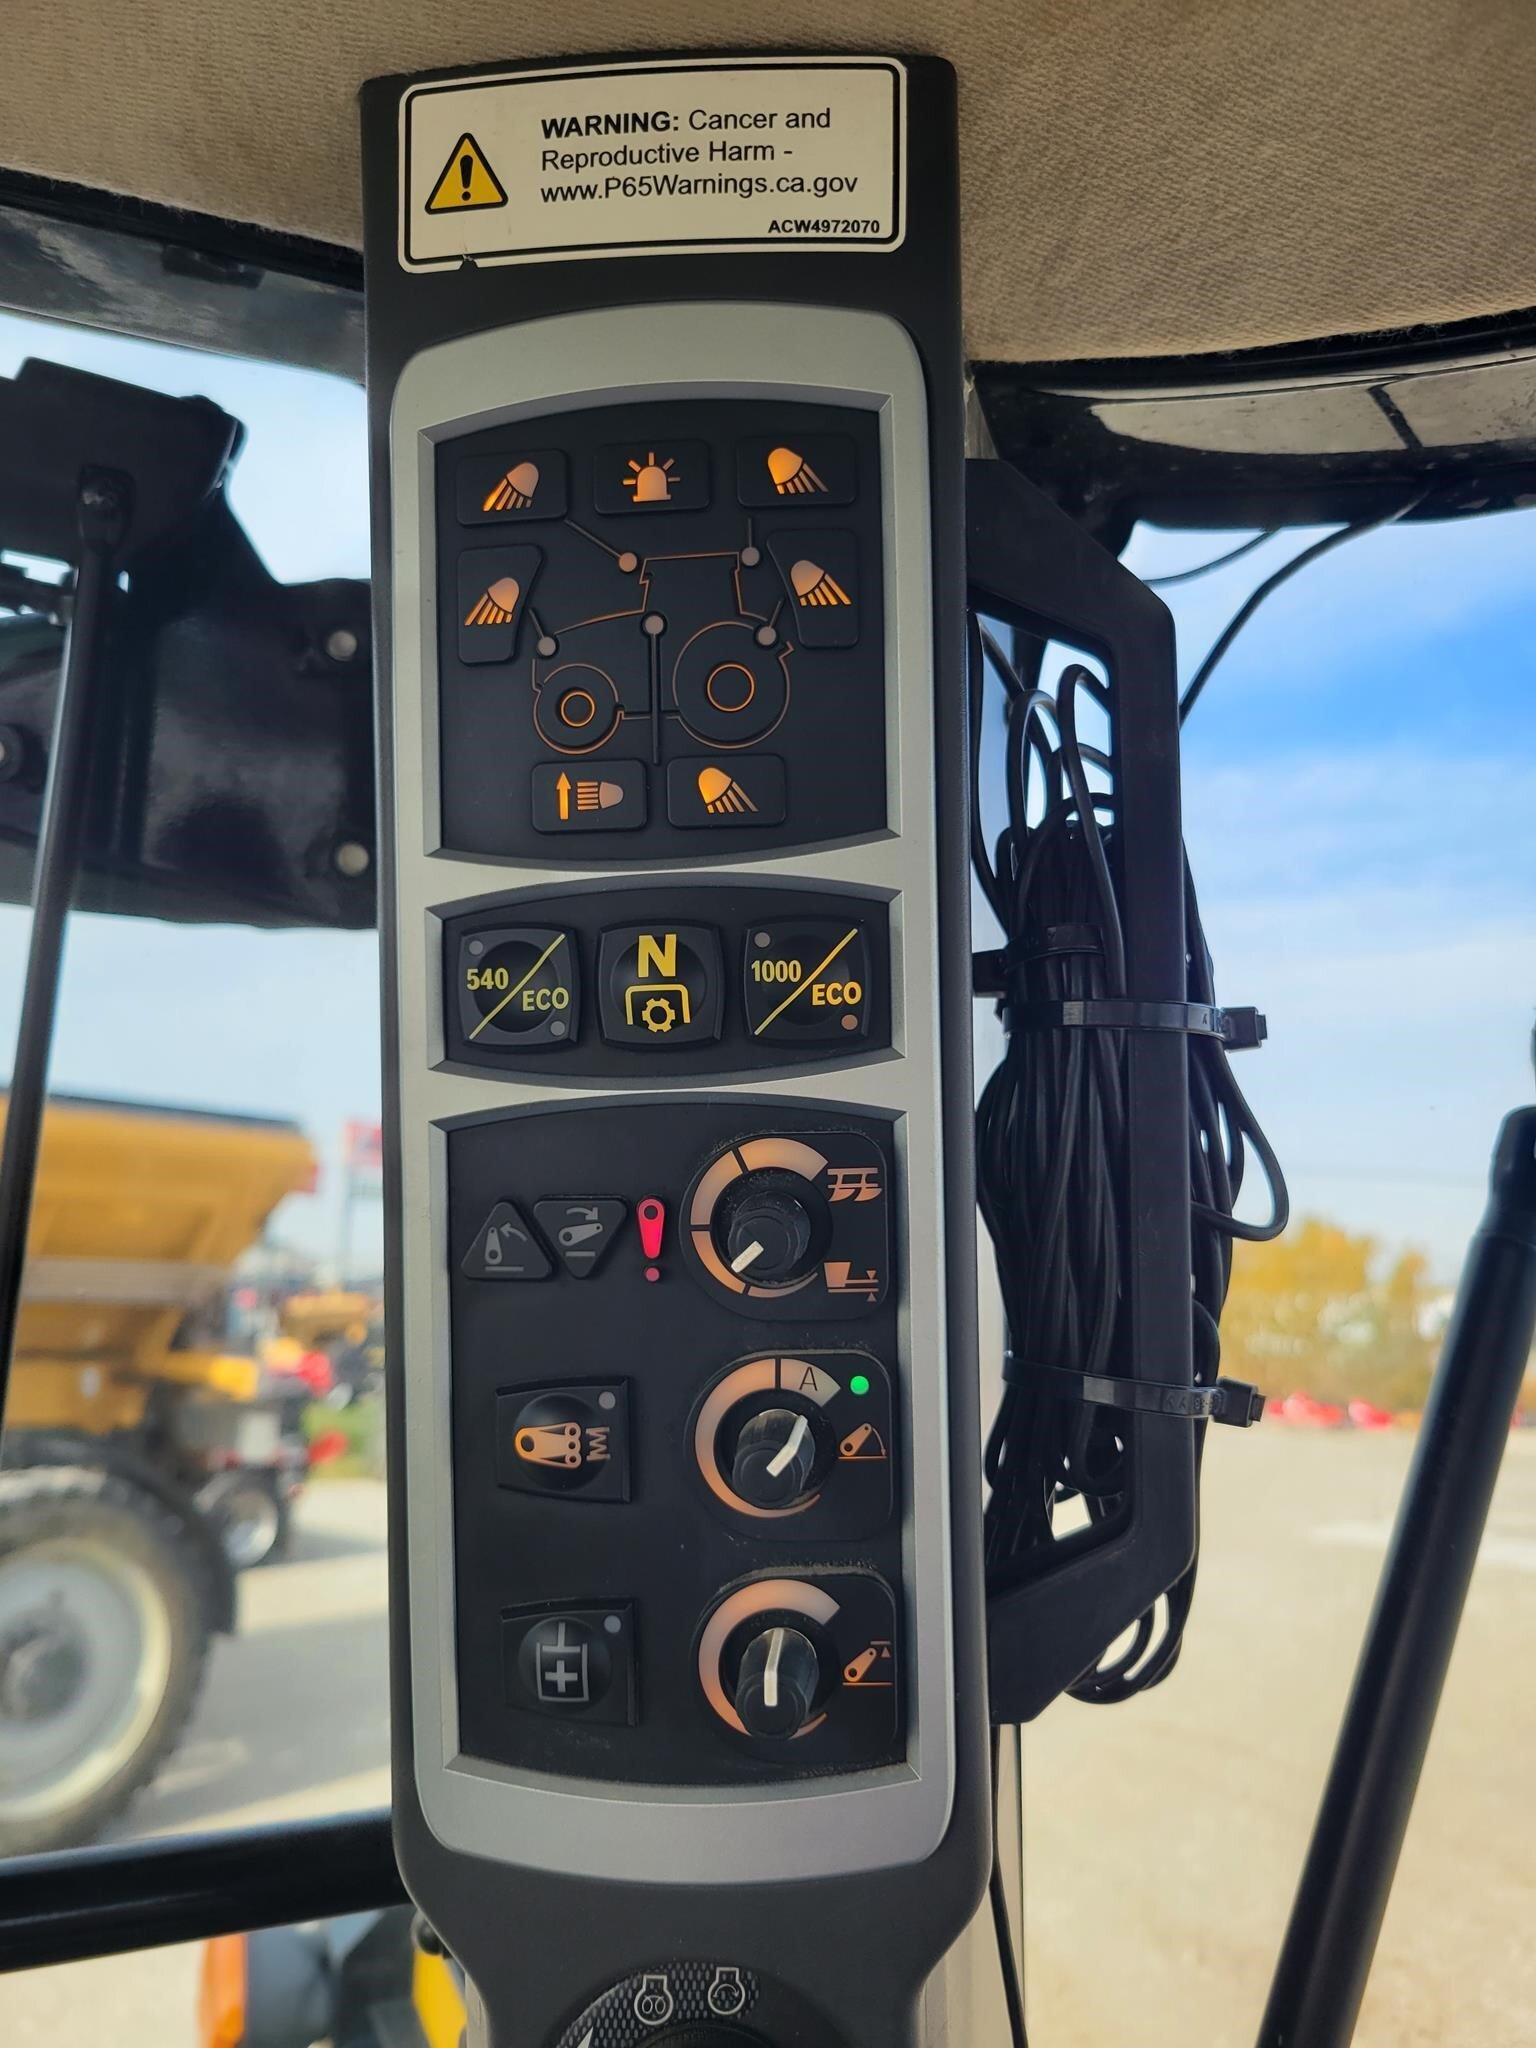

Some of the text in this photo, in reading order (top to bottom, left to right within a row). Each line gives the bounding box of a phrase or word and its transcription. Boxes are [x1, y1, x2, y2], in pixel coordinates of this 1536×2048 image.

[541, 107, 831, 139] WARNING: Cancer and
[542, 143, 700, 174] Reproductive
[709, 140, 775, 162] Harm
[541, 173, 858, 203] www.P65Warnings.ca.gov
[767, 219, 880, 234] ACW4972070
[638, 933, 677, 978] N
[466, 967, 509, 991] 540
[751, 959, 801, 983] 1000
[522, 986, 569, 1012] ECO
[812, 981, 862, 1006] ECO
[799, 1365, 818, 1391] A
